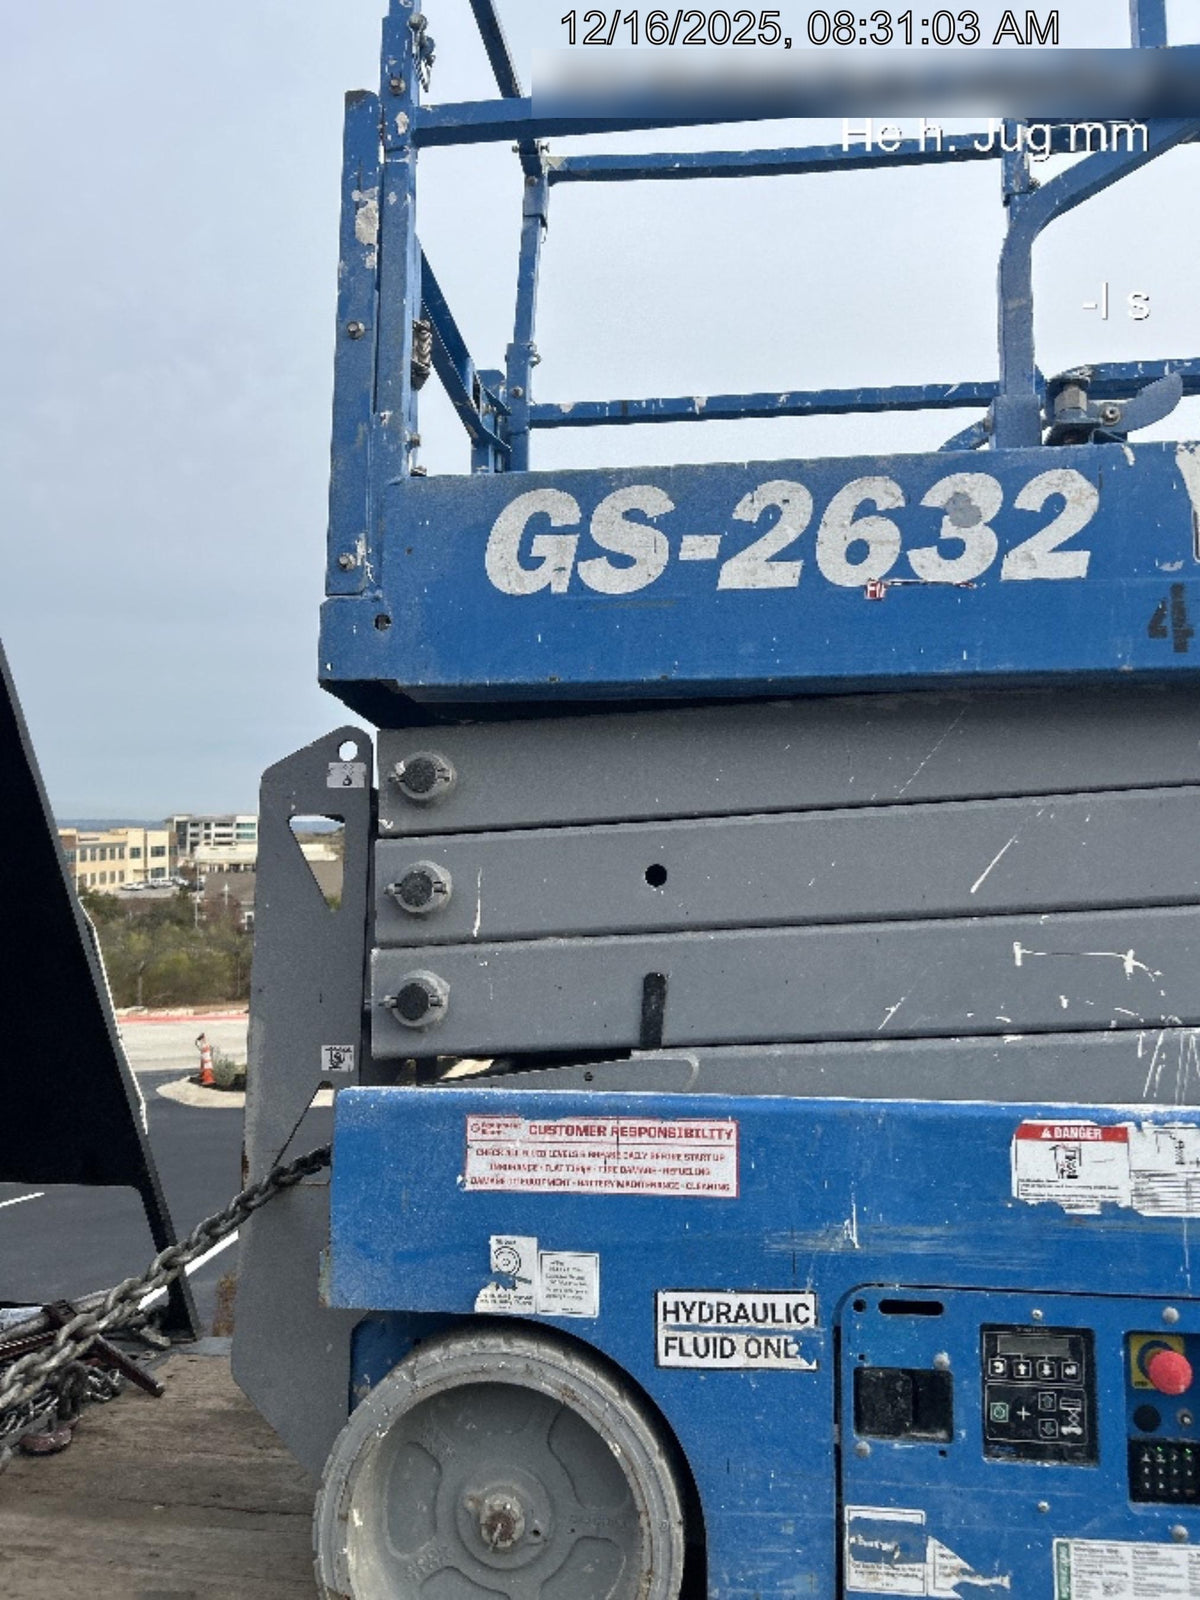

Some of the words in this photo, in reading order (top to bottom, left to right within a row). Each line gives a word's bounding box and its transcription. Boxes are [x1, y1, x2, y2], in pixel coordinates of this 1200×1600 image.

[484, 468, 1099, 596] GS-2632
[1147, 583, 1194, 653] 4
[529, 1124, 607, 1138] CUSTOMER
[610, 1126, 734, 1141] RESPONSIBILITY
[1053, 1127, 1102, 1140] DANGER
[662, 1301, 811, 1325] HYDRAULIC
[664, 1336, 736, 1359] FLUID
